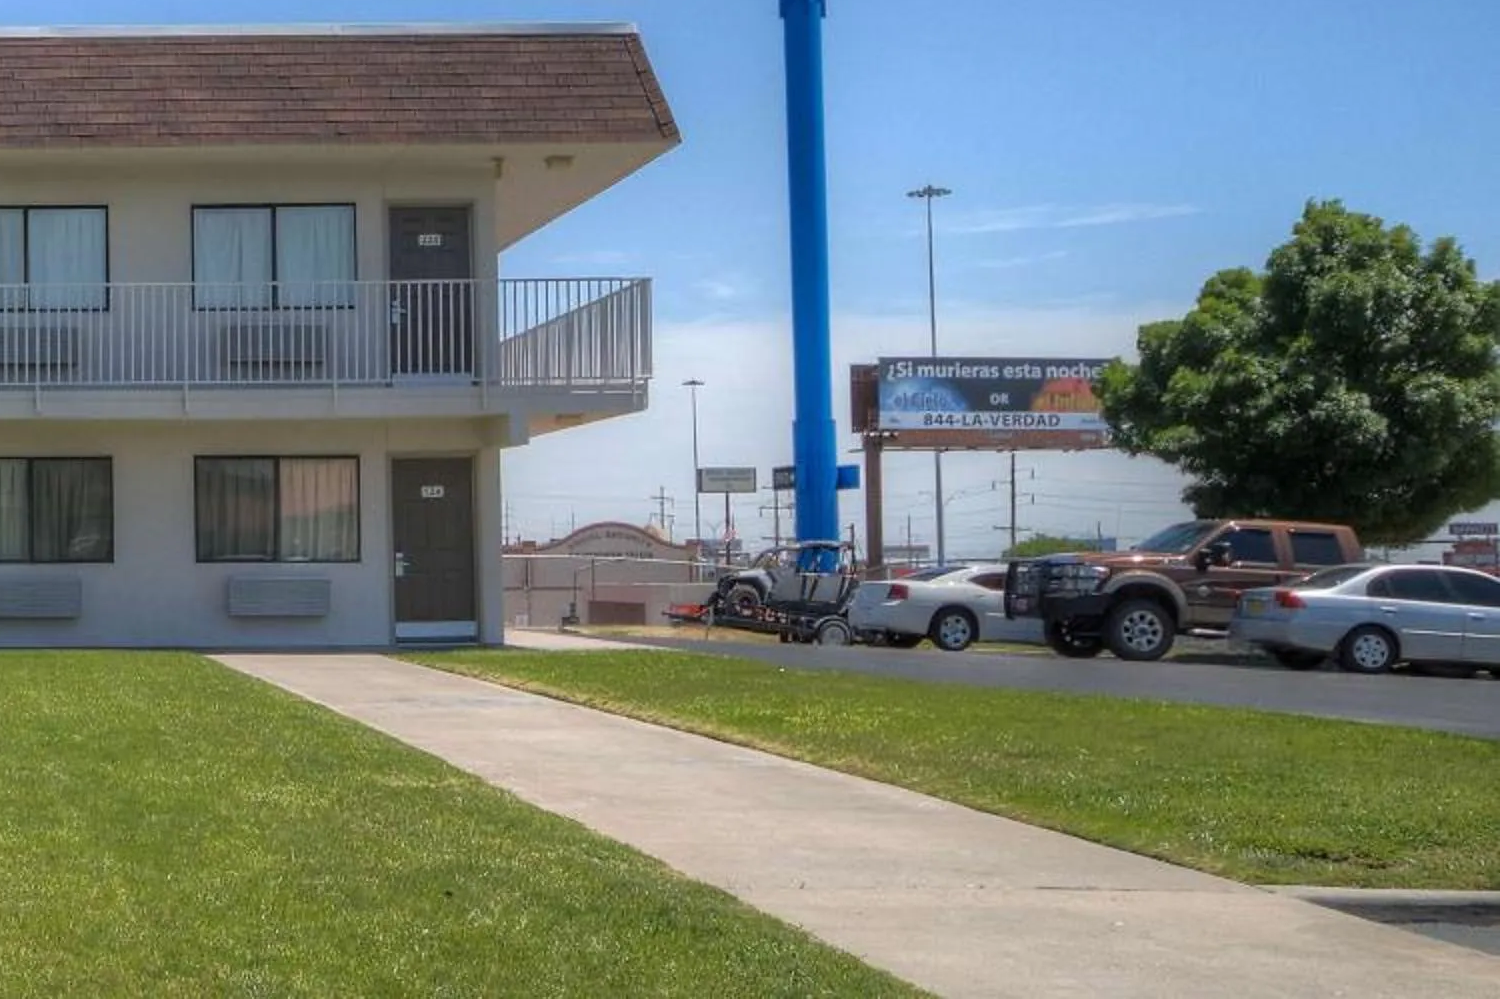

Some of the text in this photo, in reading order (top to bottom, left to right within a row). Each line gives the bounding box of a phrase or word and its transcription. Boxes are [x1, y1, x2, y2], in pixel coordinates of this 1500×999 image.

[887, 361, 1108, 381] ¿Si murieras esta noche
[923, 413, 1061, 427] 844-LA-VERDAD
